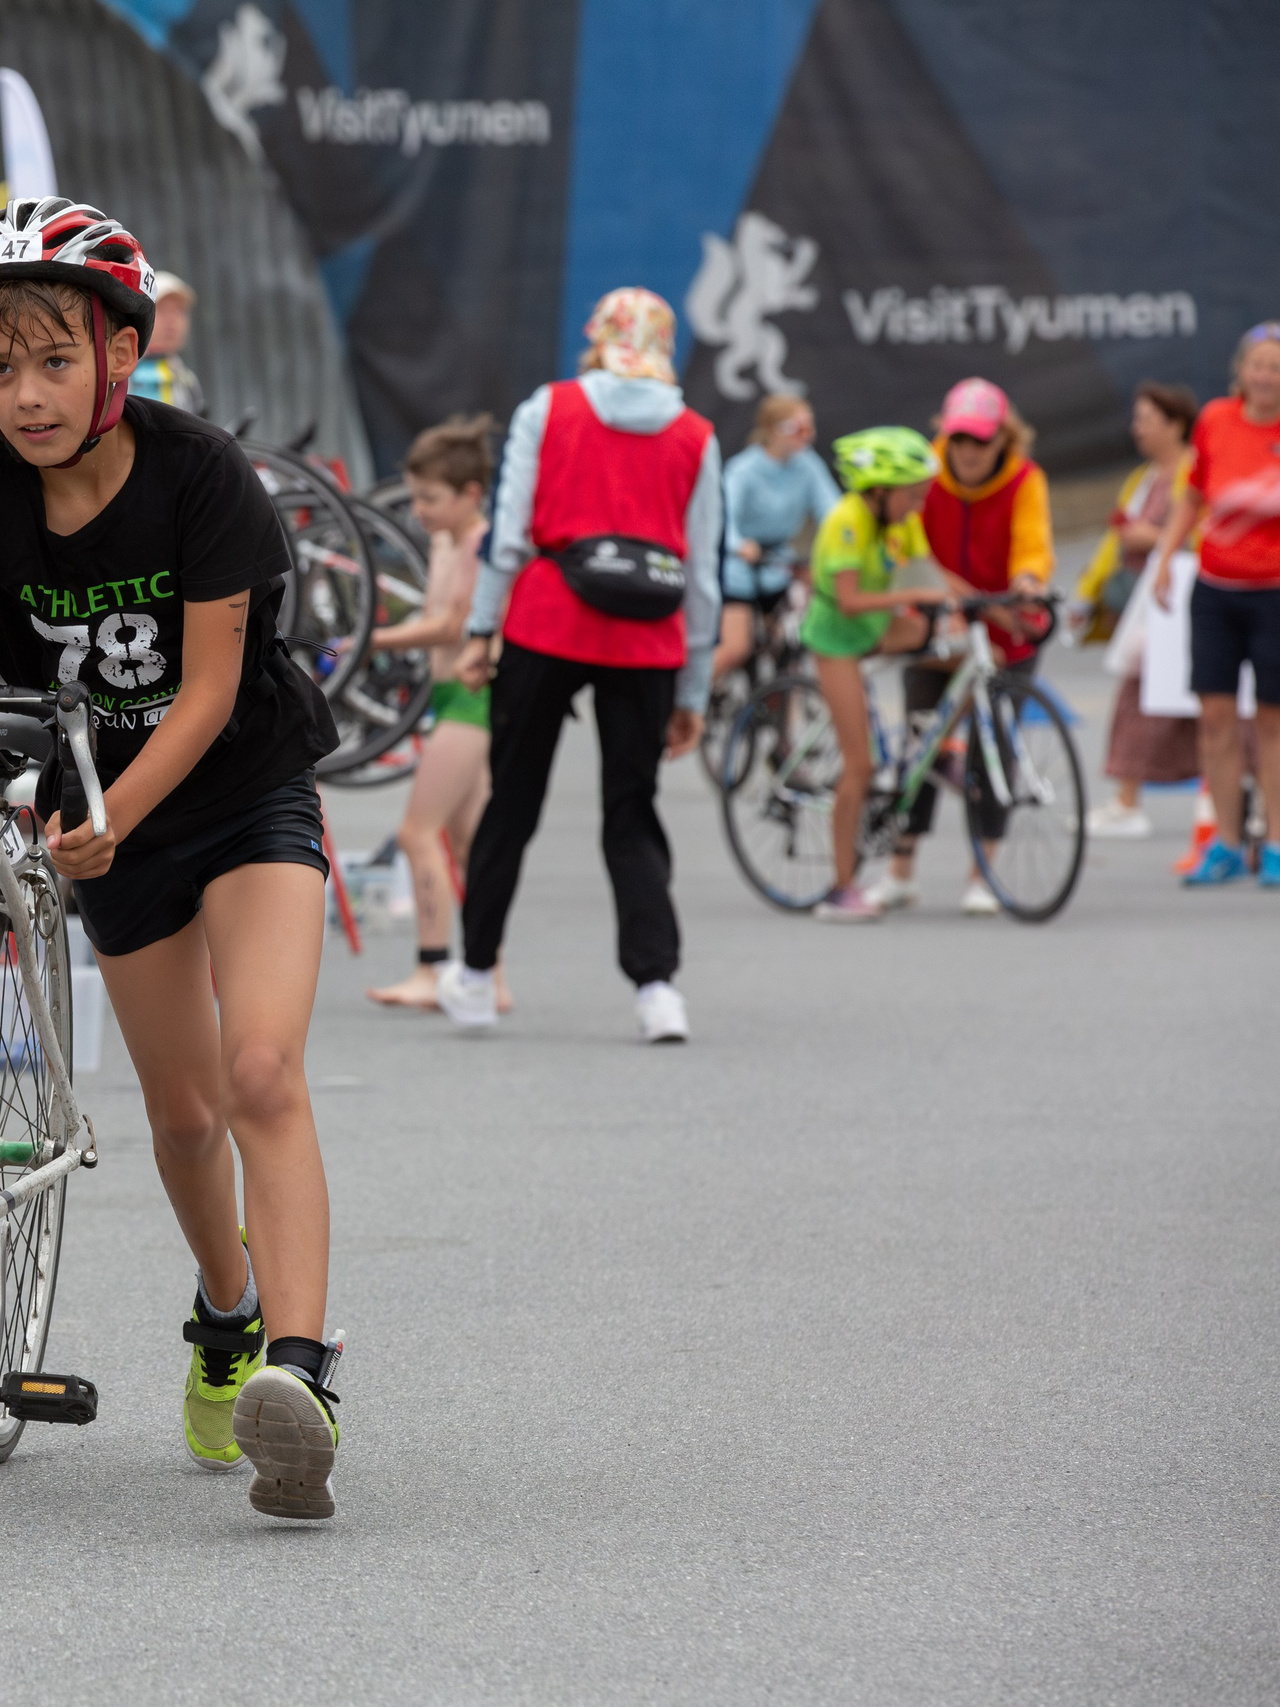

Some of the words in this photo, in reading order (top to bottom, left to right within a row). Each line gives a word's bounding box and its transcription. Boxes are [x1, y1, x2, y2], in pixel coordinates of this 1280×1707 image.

[297, 87, 549, 156] VisitTyumen
[1, 239, 31, 260] 47
[143, 270, 156, 294] 47
[844, 286, 1197, 353] VisitTyumen
[20, 570, 174, 619] ATHLETIC
[31, 613, 167, 689] 78
